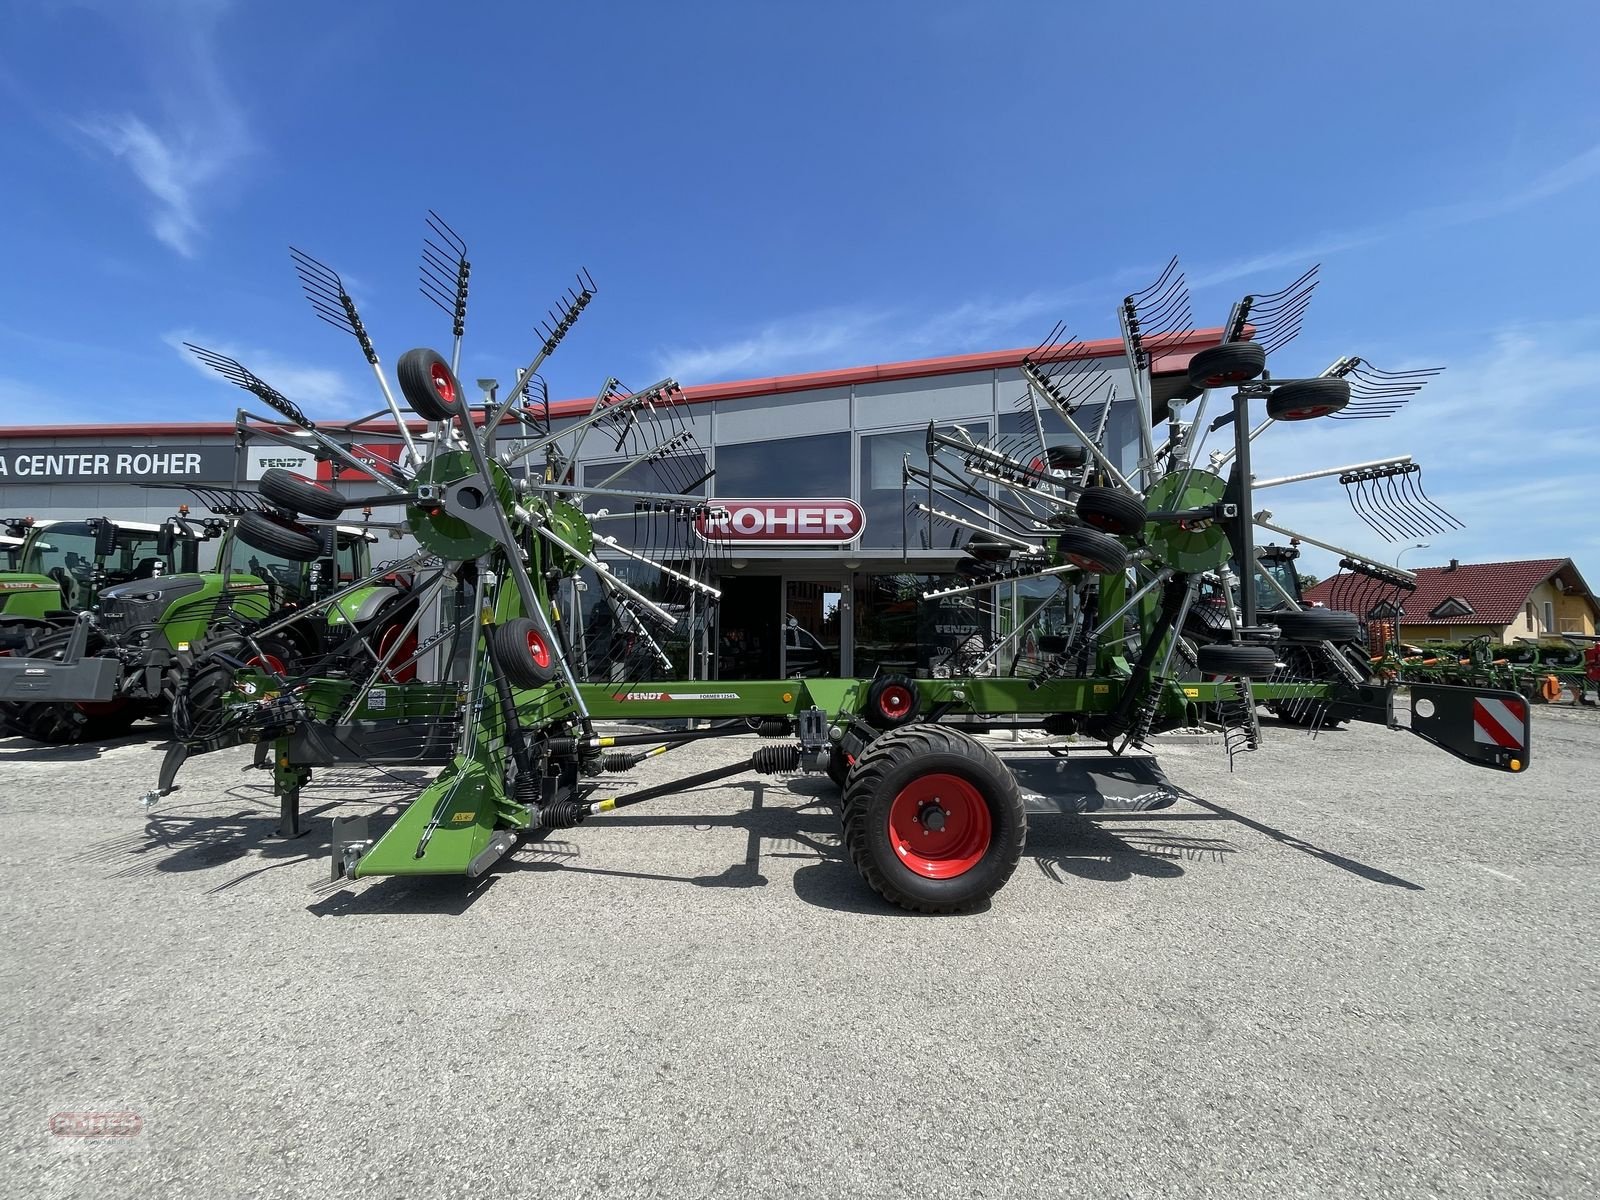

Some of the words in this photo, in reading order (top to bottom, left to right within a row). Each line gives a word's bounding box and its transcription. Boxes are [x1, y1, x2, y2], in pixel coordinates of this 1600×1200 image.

[14, 454, 110, 476] CENTER
[115, 453, 201, 475] ROHER
[259, 458, 307, 468] FENDT
[704, 507, 854, 535] ROHER
[935, 624, 979, 634] FENDT
[627, 692, 664, 700] FENDT
